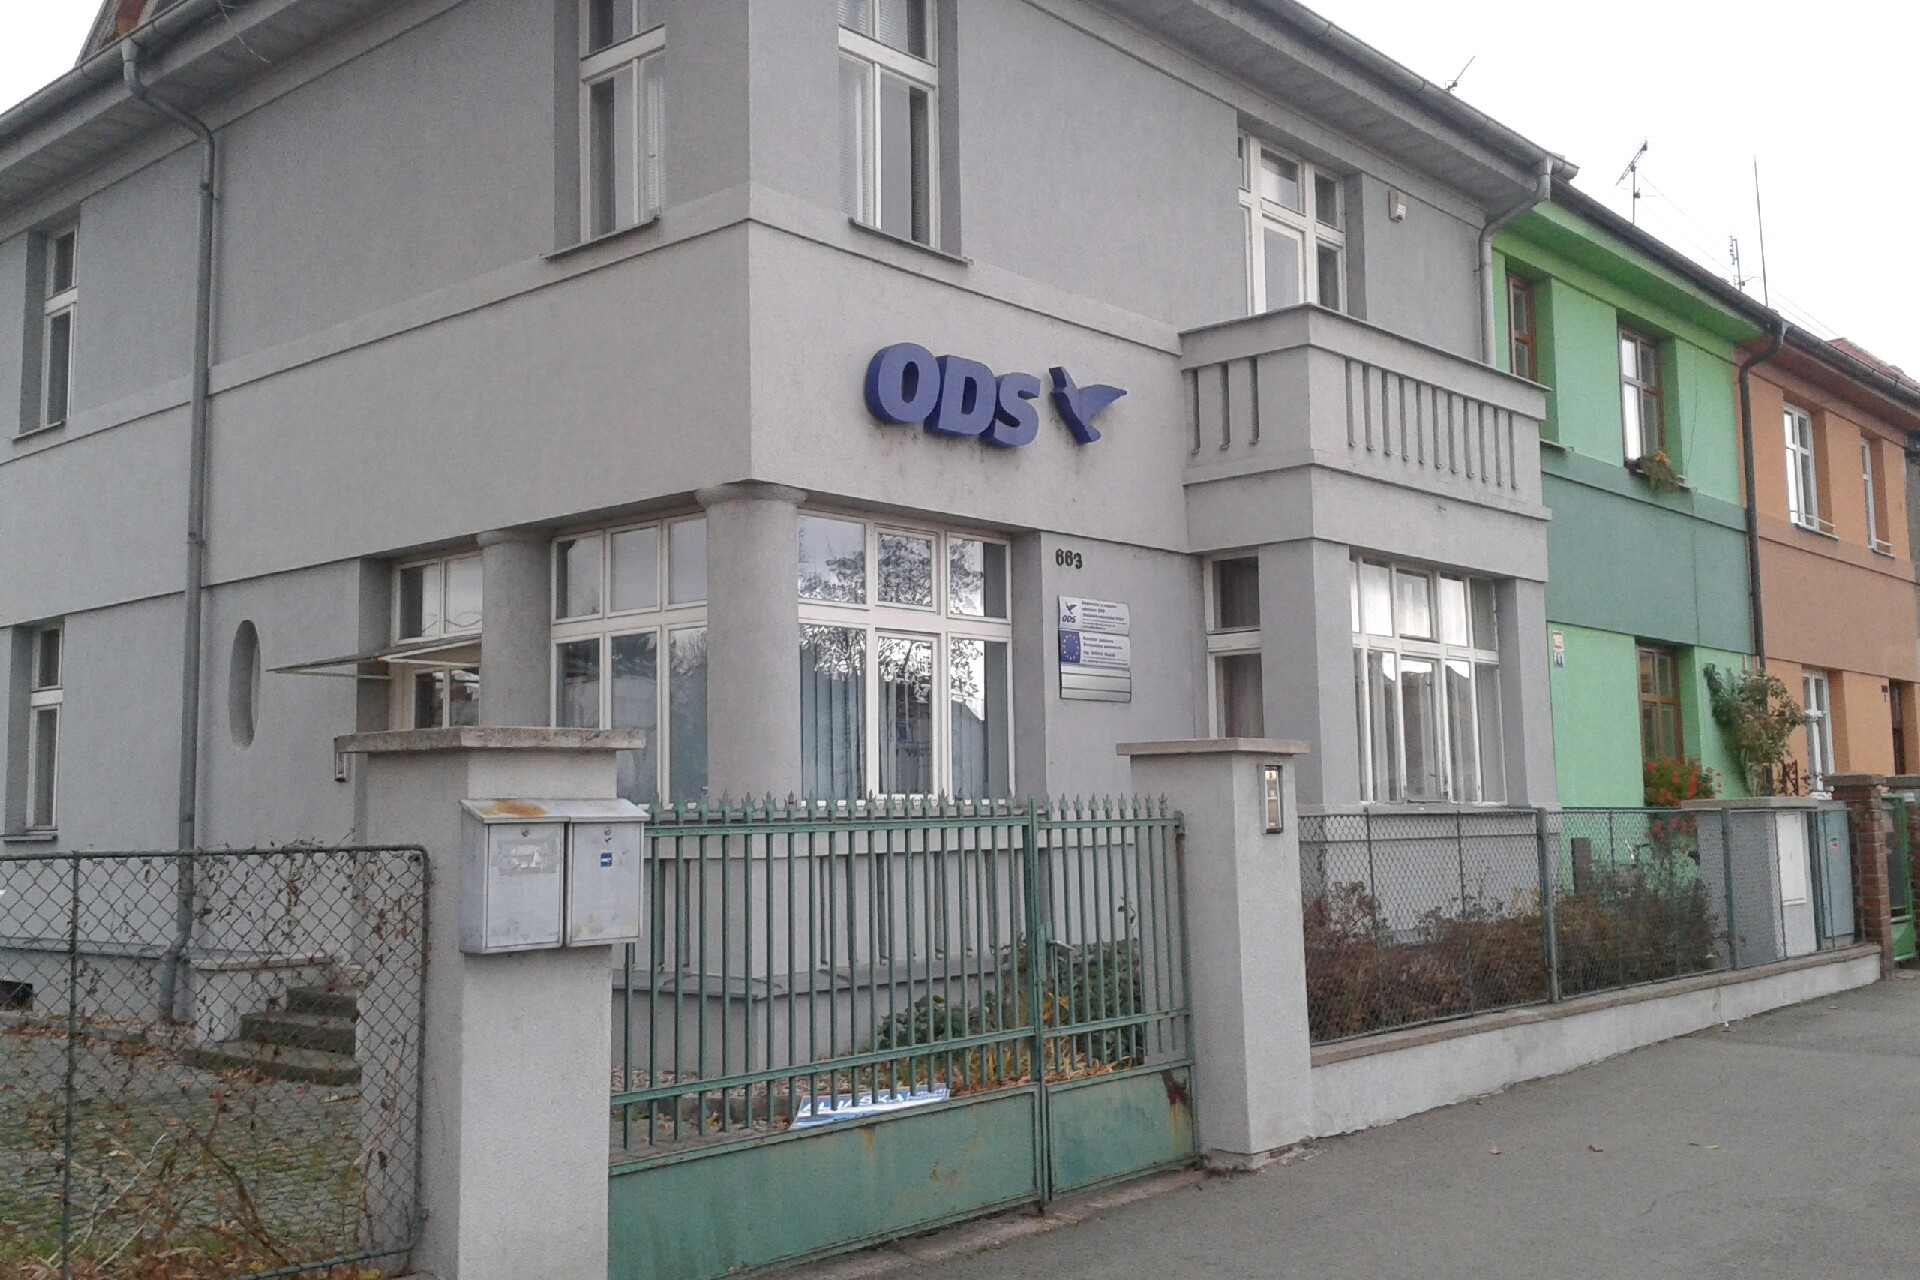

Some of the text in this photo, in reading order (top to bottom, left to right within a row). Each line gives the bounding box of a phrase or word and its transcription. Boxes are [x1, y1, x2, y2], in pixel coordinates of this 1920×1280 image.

[865, 342, 1041, 447] ODS
[1055, 548, 1083, 569] 663
[1062, 615, 1076, 624] ODS
